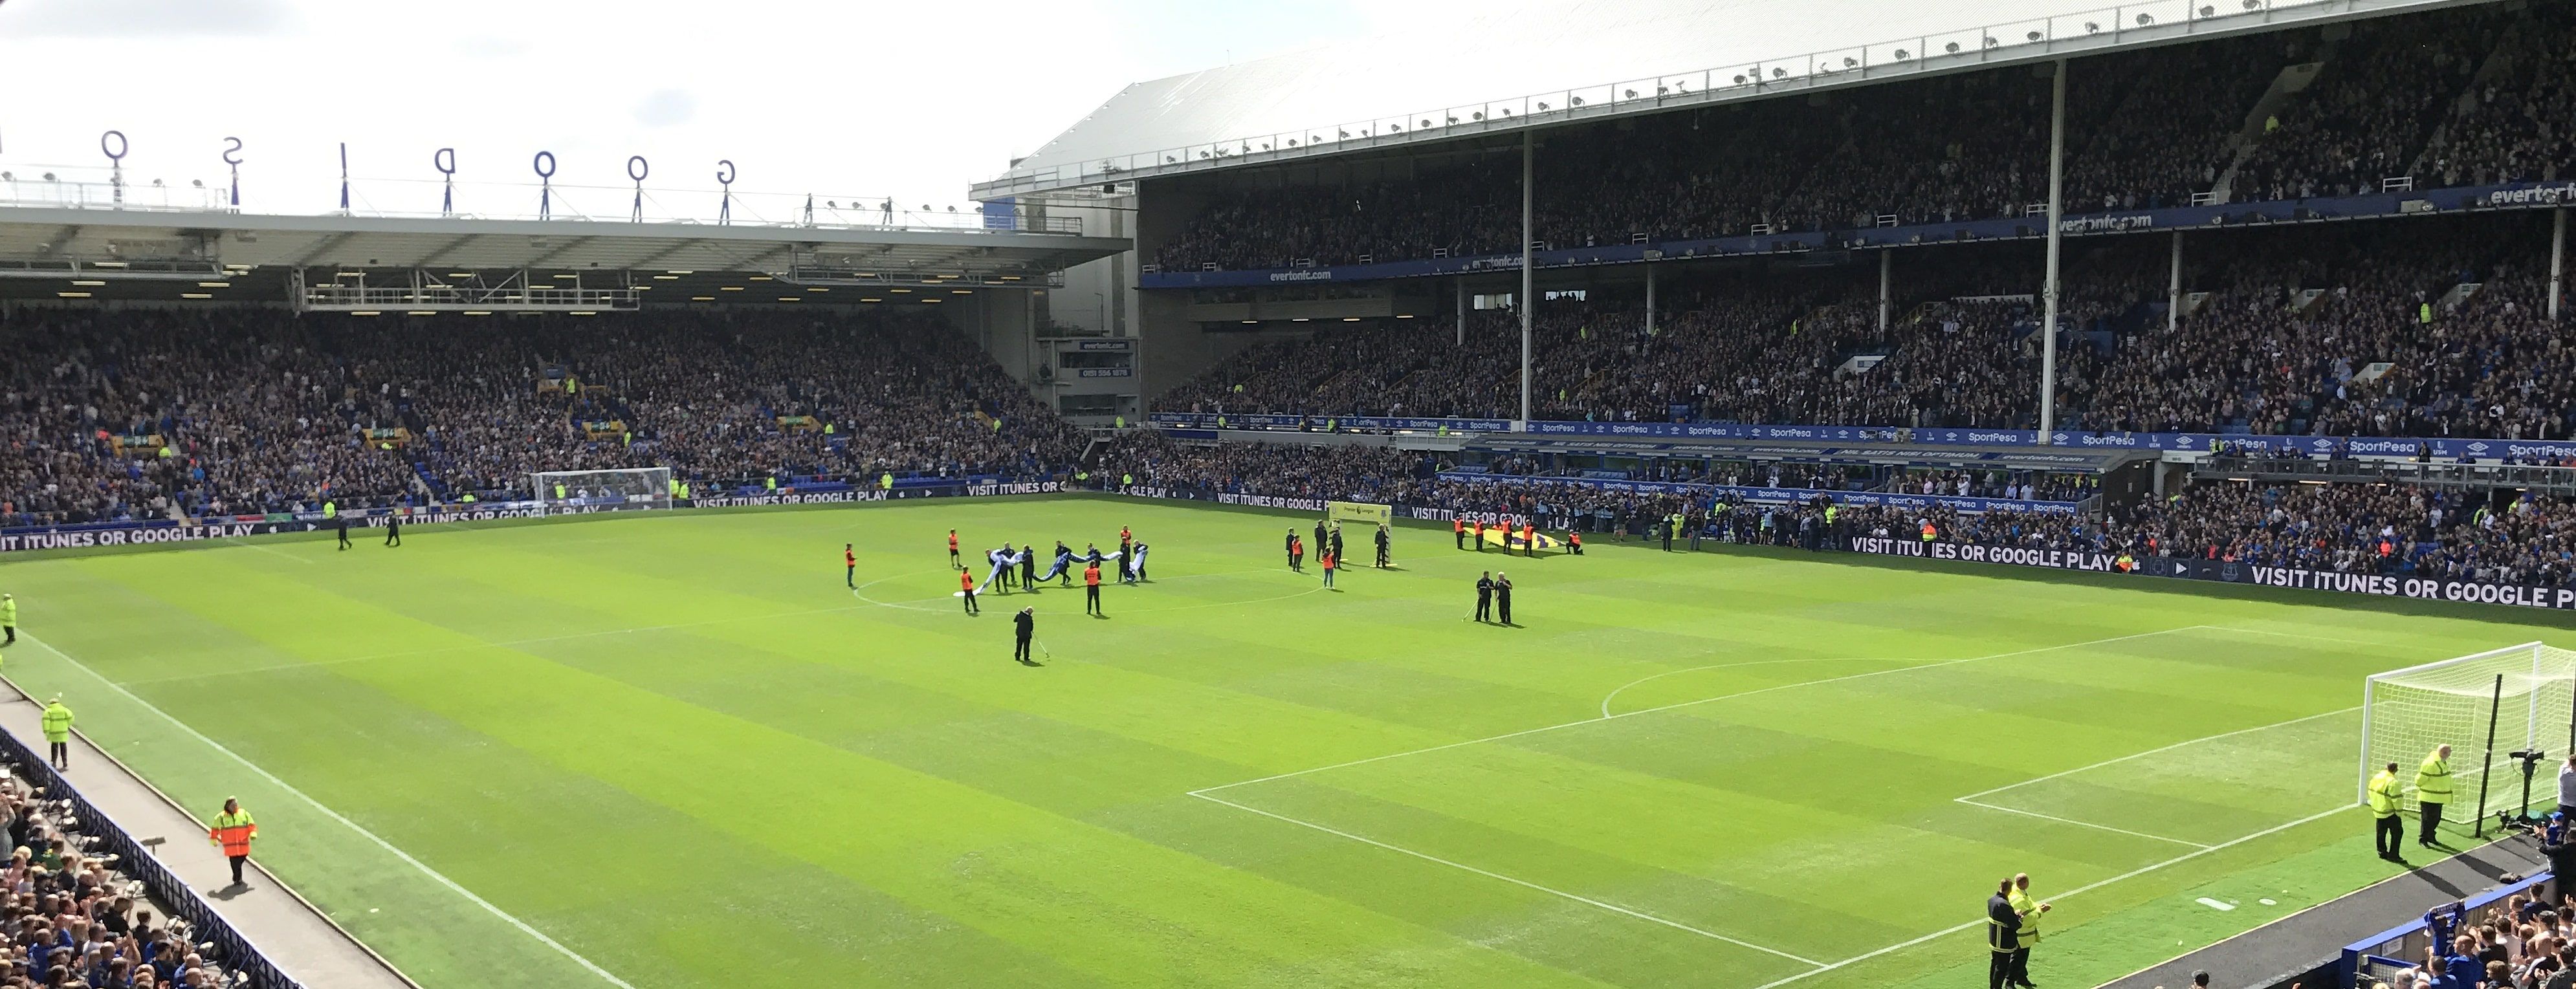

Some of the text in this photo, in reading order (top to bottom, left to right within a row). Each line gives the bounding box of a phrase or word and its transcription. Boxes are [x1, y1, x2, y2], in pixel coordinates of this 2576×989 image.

[1270, 270, 1332, 281] evertonfc.com
[1470, 422, 1501, 430] SportPesa
[1542, 424, 1576, 433] SportPesa
[1612, 424, 1648, 435] SportPesa
[1688, 426, 1727, 437] SportPesa
[1770, 428, 1812, 440] SportPesa
[1968, 433, 2018, 444] SportPesa
[2082, 435, 2135, 446] SportPesa
[2350, 440, 2416, 454] SportPesa
[2003, 454, 2085, 462] evertonfc.com
[967, 484, 998, 497] VISIT
[1042, 481, 1057, 492] OR
[1147, 487, 1167, 499] PLAY
[1758, 490, 1790, 499] SportPesa
[693, 499, 730, 509] VISIT
[782, 495, 801, 505] OR
[804, 492, 855, 505] GOOGLE
[857, 490, 889, 501] PLAY
[1217, 493, 1240, 505] VISIT
[1272, 497, 1286, 508] OR
[1287, 498, 1323, 512] GOOGLE
[2034, 505, 2075, 514] SportPesa
[1411, 507, 1439, 521] VISIT
[1482, 511, 1497, 525] OR
[100, 530, 127, 546] OR
[131, 526, 204, 545] GOOGLE
[209, 524, 255, 538] PLAY
[1852, 536, 1893, 555] VISIT
[1961, 545, 1985, 562] OR
[1990, 547, 2061, 568] GOOGLE
[2066, 552, 2115, 572] PLAY
[2251, 566, 2309, 588] VISIT
[2315, 571, 2397, 596] iTUNES
[2404, 578, 2439, 599] OR
[2445, 582, 2548, 607] GOOGLE
